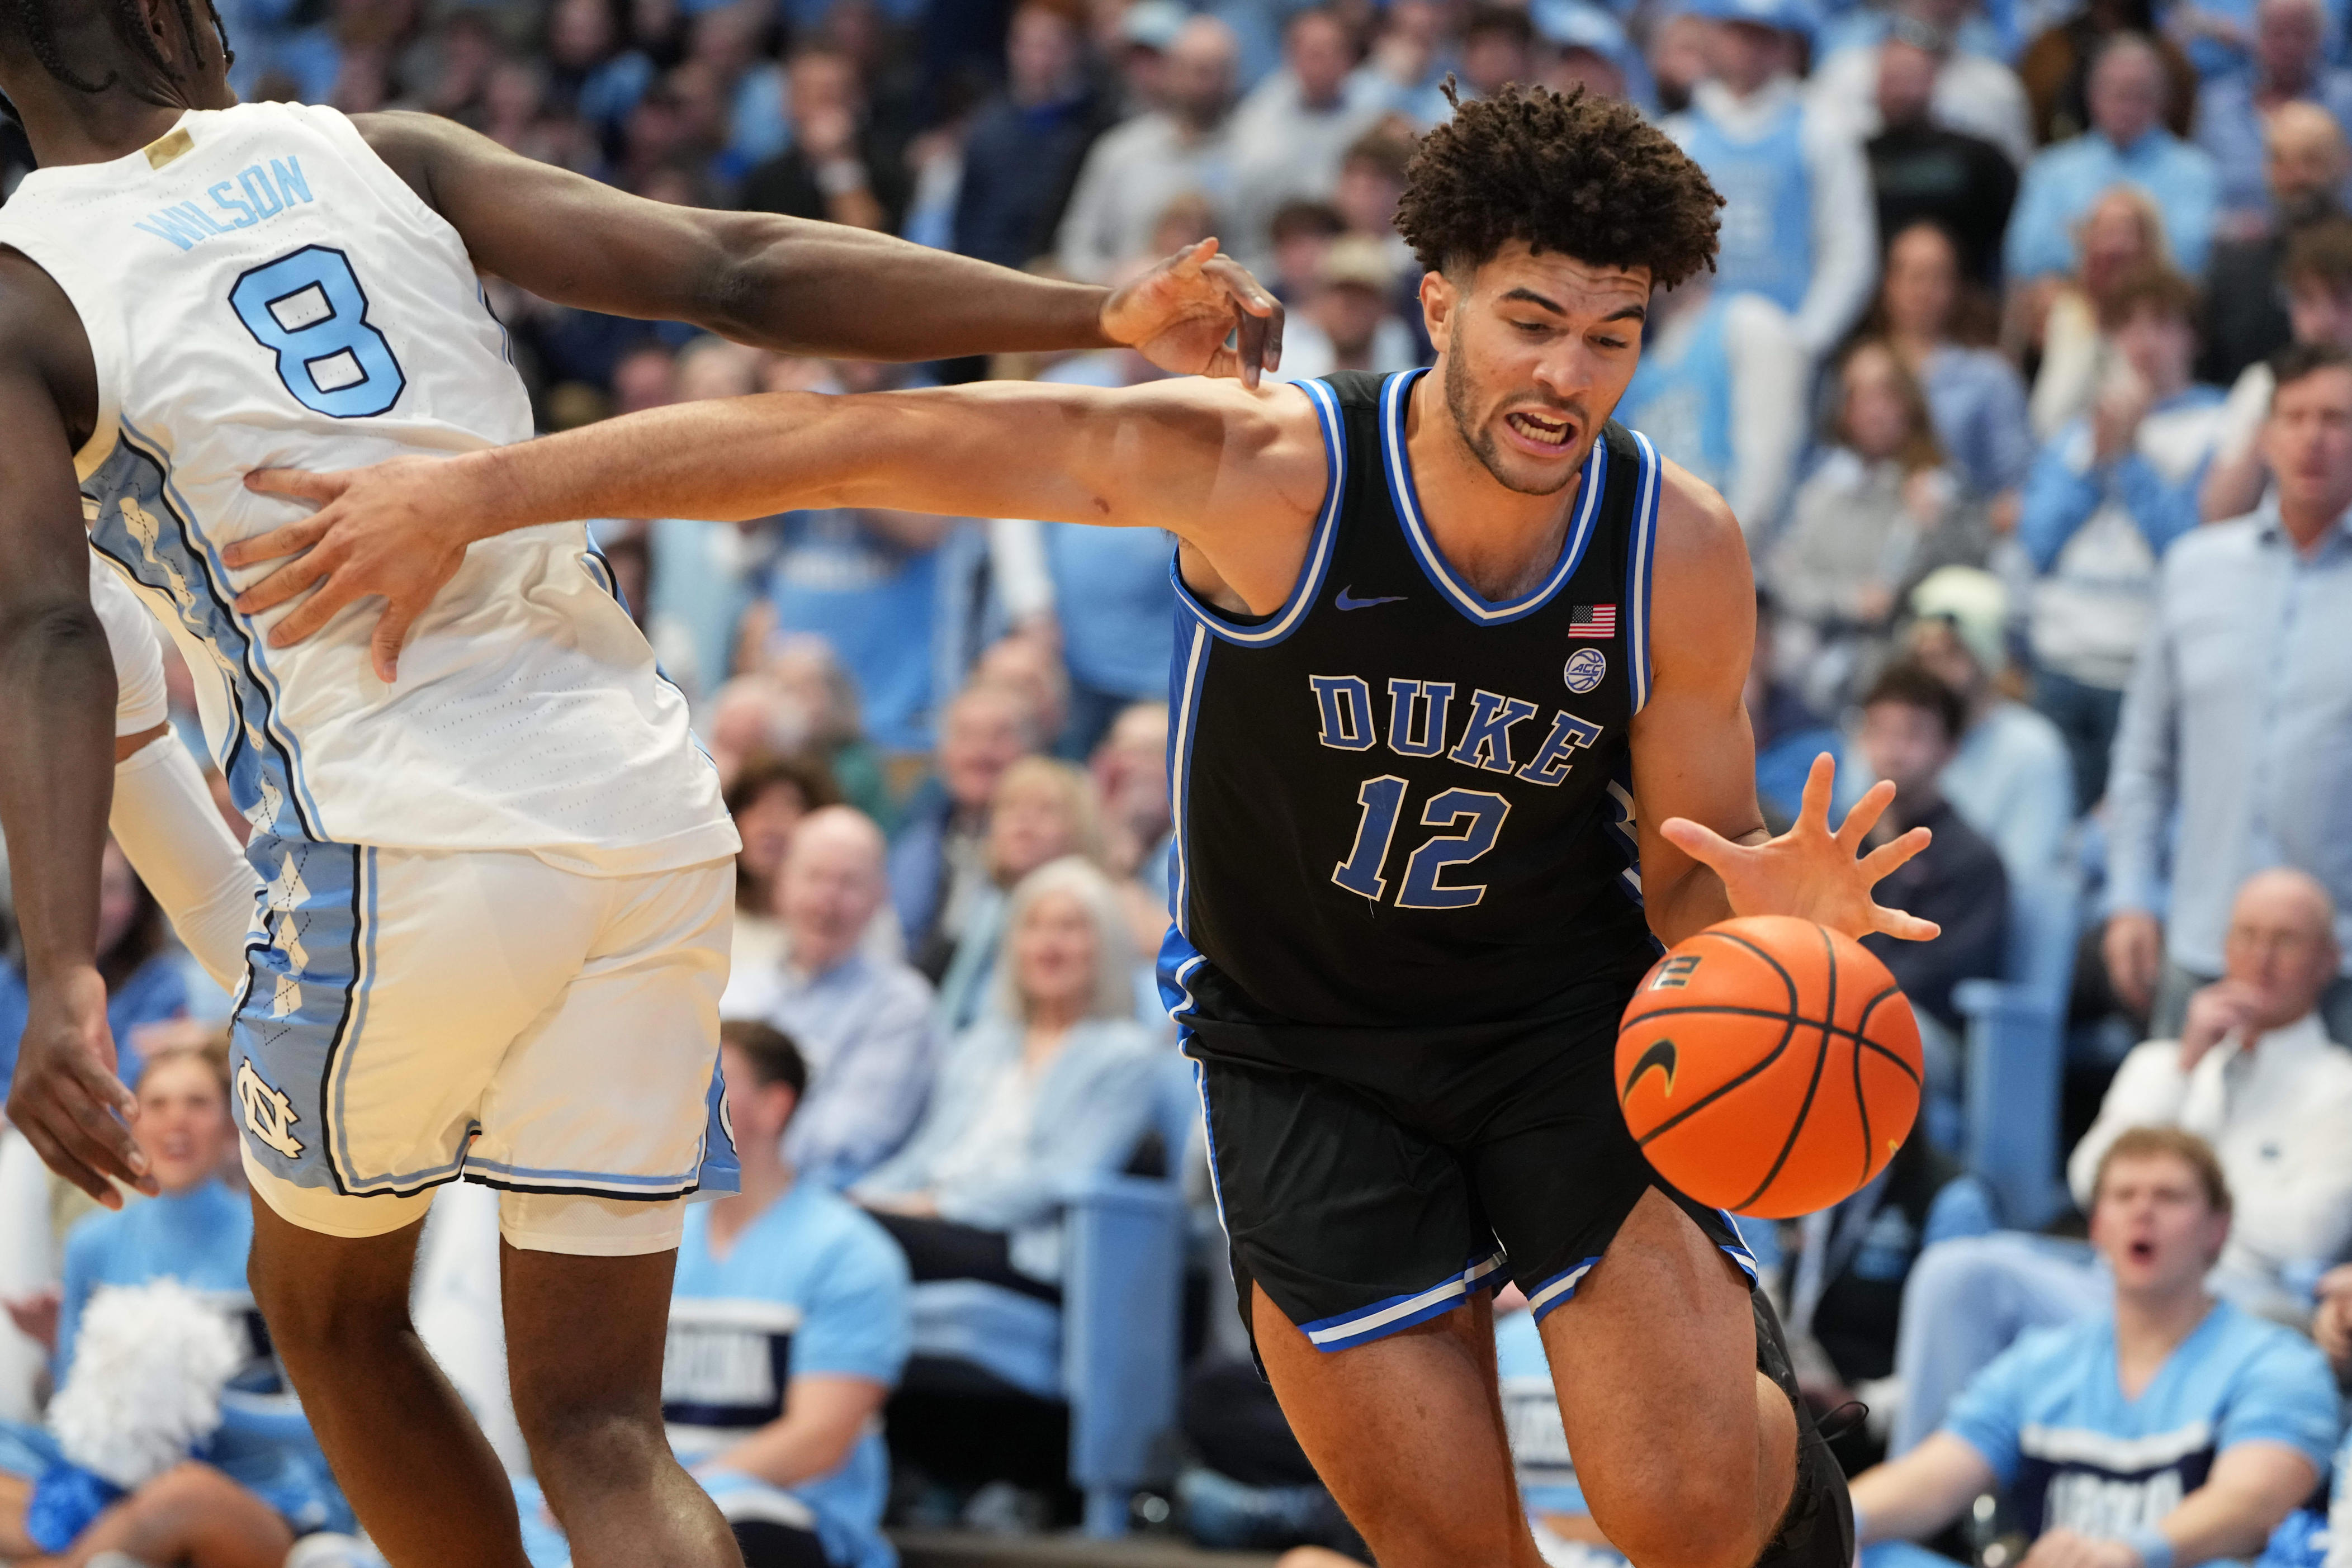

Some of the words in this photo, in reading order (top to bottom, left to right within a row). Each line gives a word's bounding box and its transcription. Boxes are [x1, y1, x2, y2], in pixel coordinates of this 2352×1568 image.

[134, 155, 313, 250] WILSON
[228, 244, 406, 418] 8
[1570, 664, 1603, 676] ACC
[1309, 674, 1603, 787] DUKE
[1331, 774, 1512, 909] 12
